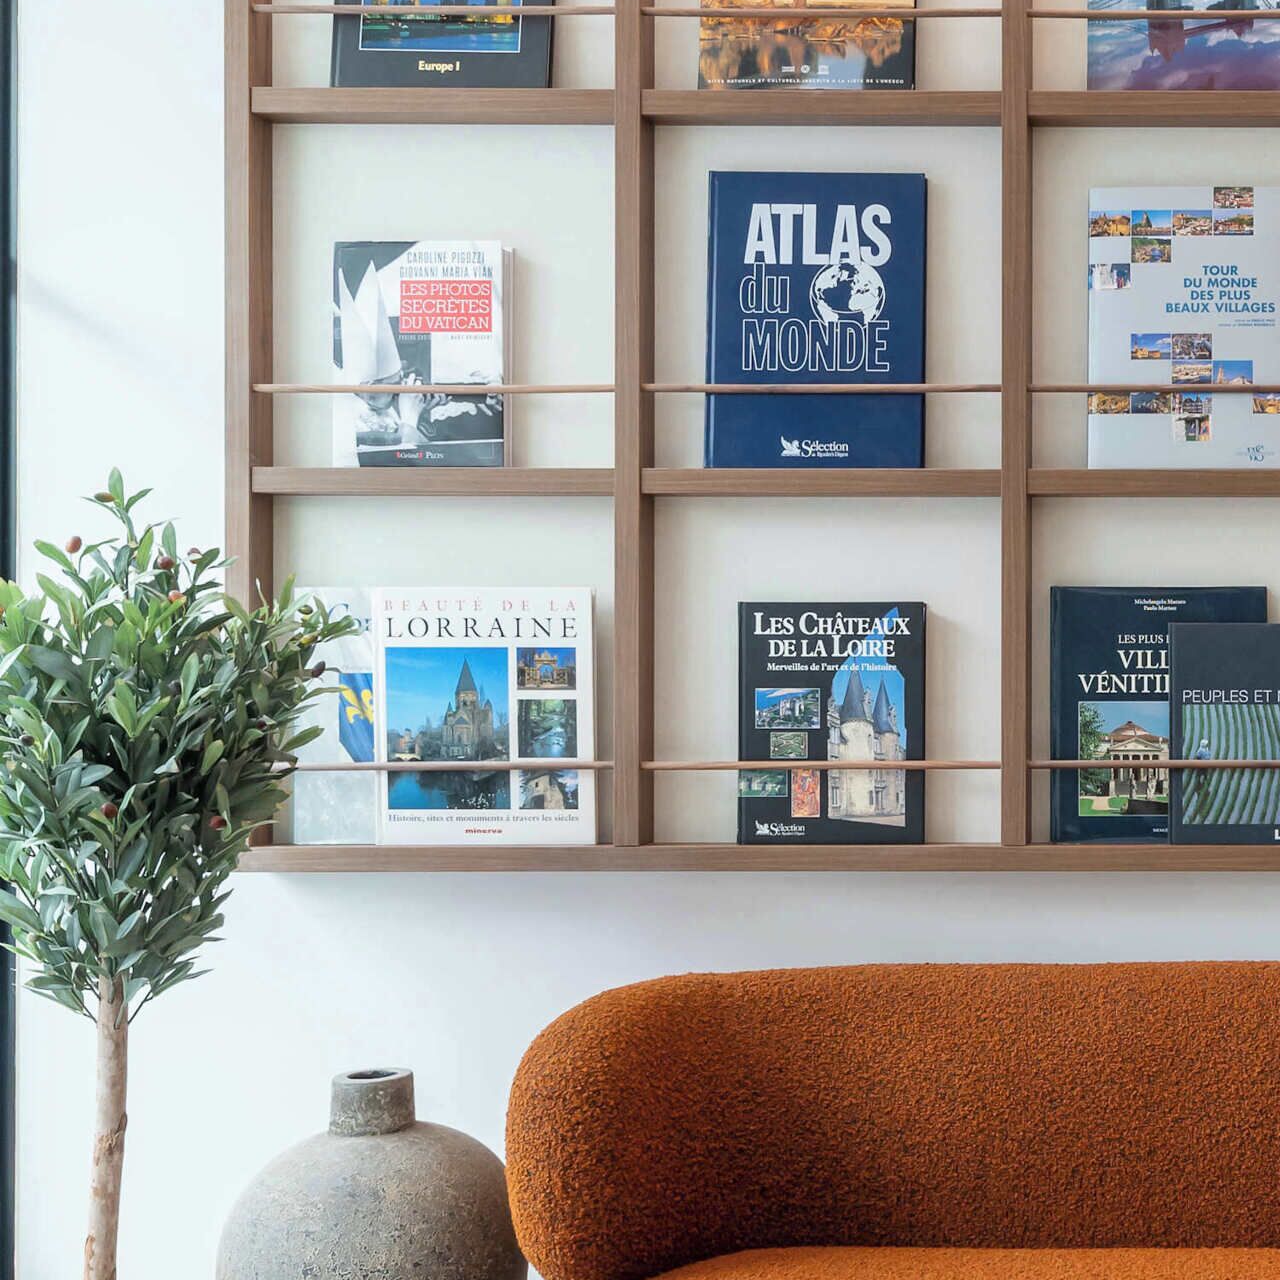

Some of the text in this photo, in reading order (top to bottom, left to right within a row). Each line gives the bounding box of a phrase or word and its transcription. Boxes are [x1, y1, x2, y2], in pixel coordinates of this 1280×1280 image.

[418, 60, 453, 74] Europe
[743, 203, 892, 267] ATLAS
[1202, 265, 1238, 276] TOUR
[402, 283, 490, 295] LES PHOTOS
[739, 262, 789, 314] du
[1183, 278, 1257, 288] DU MONDE
[1190, 290, 1251, 300] DES PLUS
[401, 297, 490, 313] SECRÈTES
[1165, 302, 1276, 313] BEAUX VILLAGES
[402, 316, 489, 329] DU VATICAN
[742, 319, 890, 372] MONDE
[801, 440, 849, 457] Sélection
[384, 597, 577, 612] BEAUTÉ DE LA
[386, 617, 578, 638] LORRAINE
[753, 612, 911, 635] LES CHÂTEAUX
[768, 634, 896, 657] DE LA LOIRE
[1118, 634, 1136, 644] LES
[1138, 634, 1164, 644] PLUS
[767, 663, 808, 671] Merveilles
[810, 663, 820, 671] de
[1182, 689, 1249, 703] PEUPLES
[1254, 690, 1273, 703] ET
[388, 814, 425, 823] Histoire,
[426, 814, 444, 822] sites
[447, 814, 454, 822] et
[542, 814, 552, 822] les
